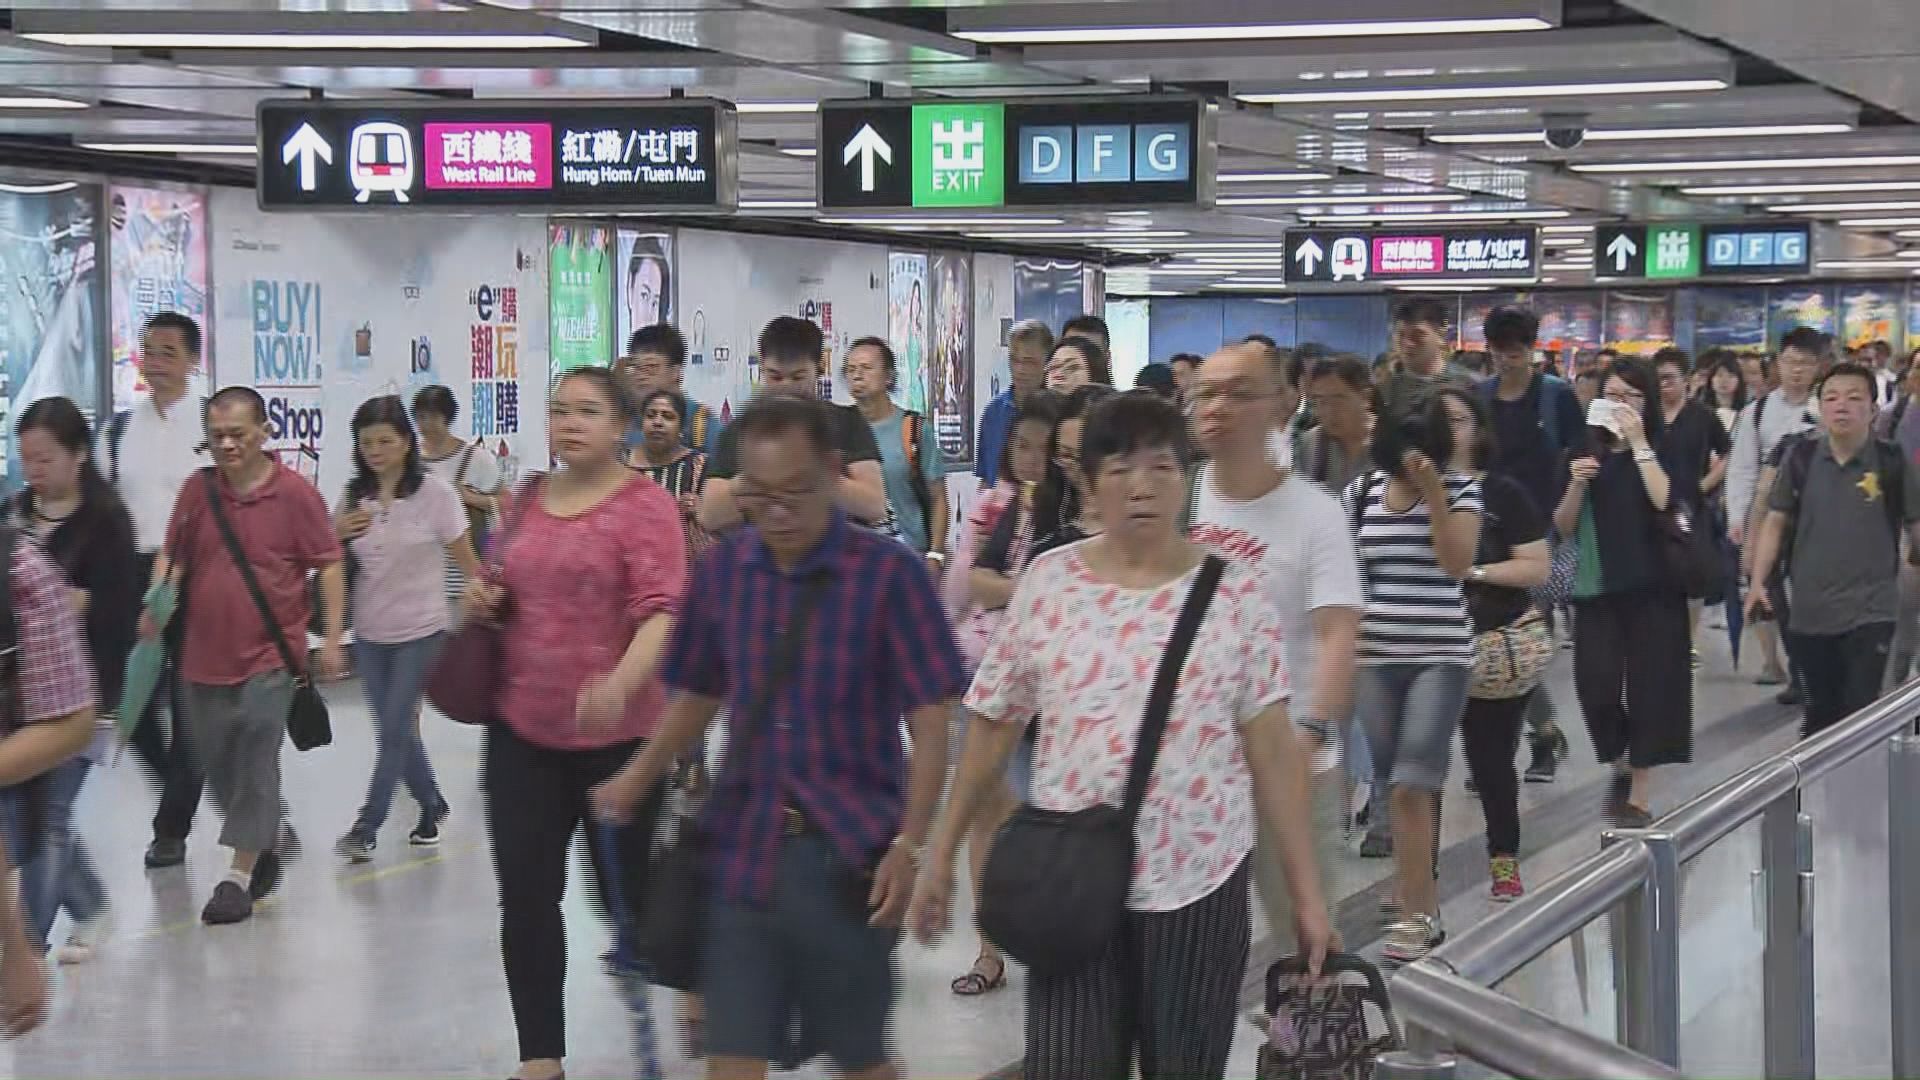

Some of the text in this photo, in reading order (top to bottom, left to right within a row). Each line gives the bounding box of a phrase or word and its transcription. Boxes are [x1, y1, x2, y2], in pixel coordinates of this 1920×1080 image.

[932, 119, 985, 169] 出
[1032, 133, 1178, 174] D F G
[442, 166, 536, 183] West Rail Line
[563, 166, 599, 186] Hung
[601, 166, 632, 182] Hom
[641, 166, 674, 182] Tuen
[676, 166, 705, 182] Mun
[932, 171, 983, 191] EXIT
[1714, 237, 1800, 260] D F G
